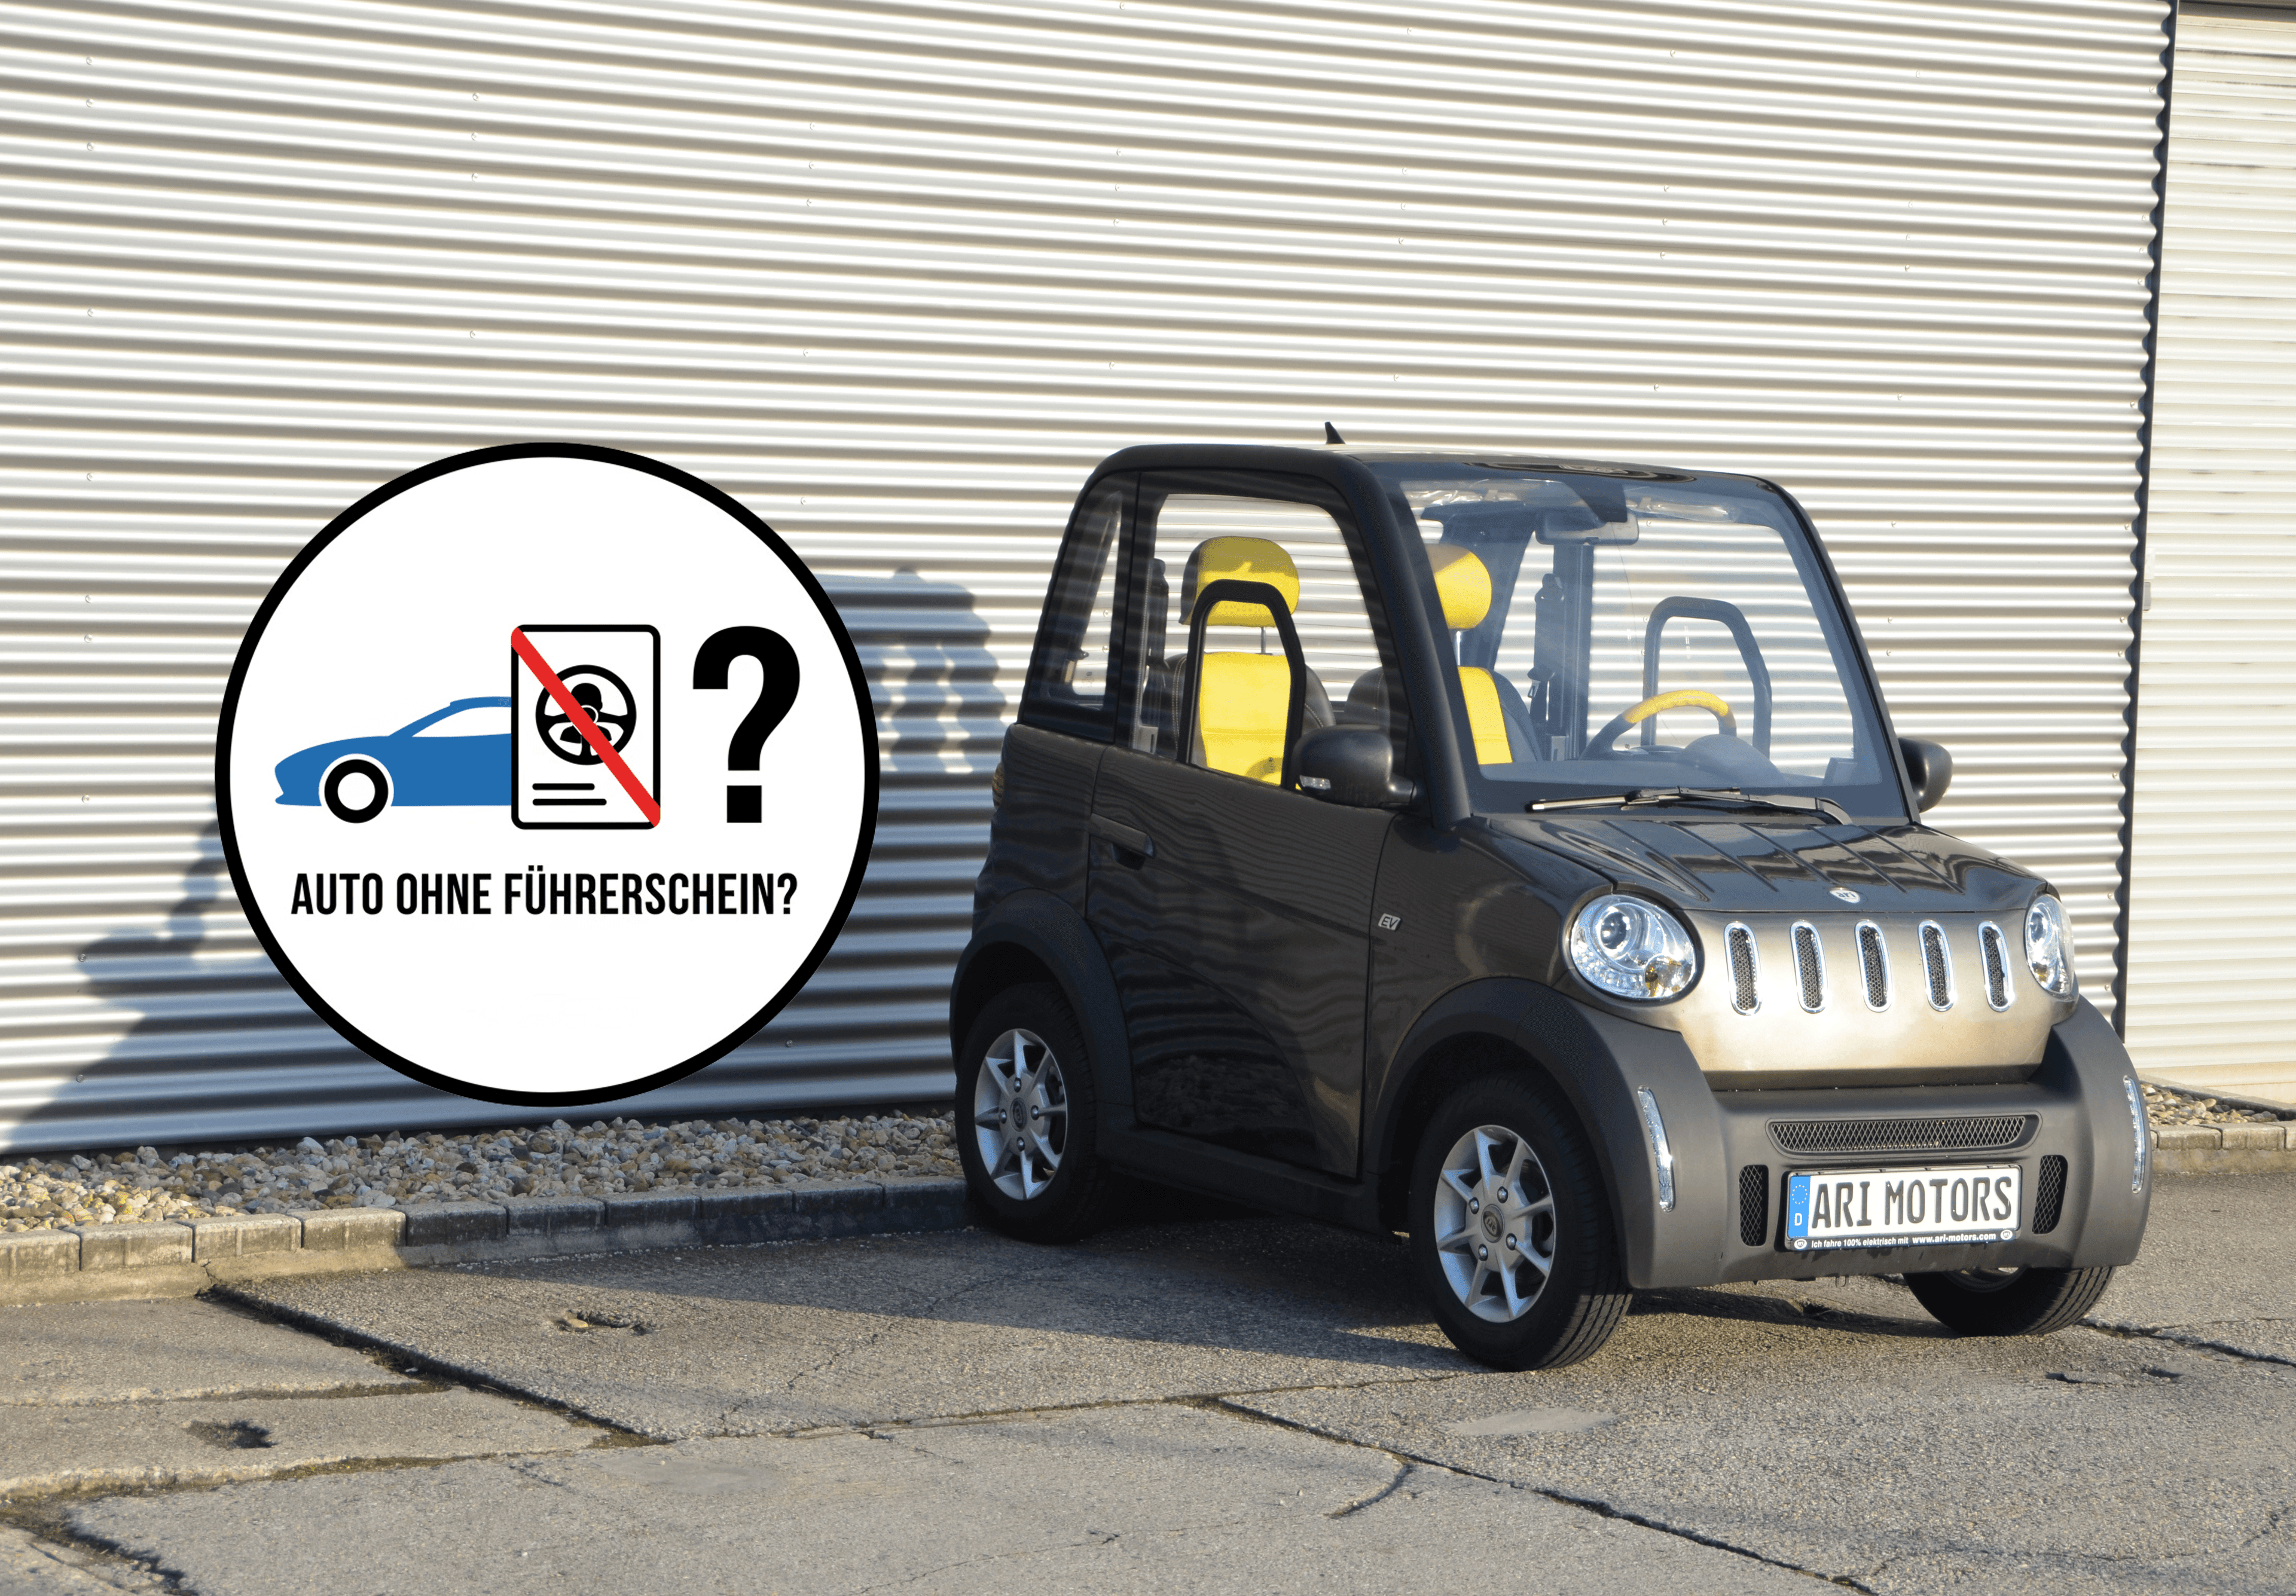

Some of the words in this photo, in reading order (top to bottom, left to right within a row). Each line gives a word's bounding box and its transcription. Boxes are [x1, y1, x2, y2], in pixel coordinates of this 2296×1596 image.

[1381, 916, 1399, 928] EV
[1812, 1181, 1872, 1229] ARI
[1885, 1176, 2012, 1225] MOTORS
[1794, 1212, 1803, 1226] D
[1811, 1240, 1822, 1248] Ich
[1824, 1239, 1842, 1248] fahre
[1863, 1237, 1896, 1246] elektrisch
[1898, 1236, 1909, 1245] mit
